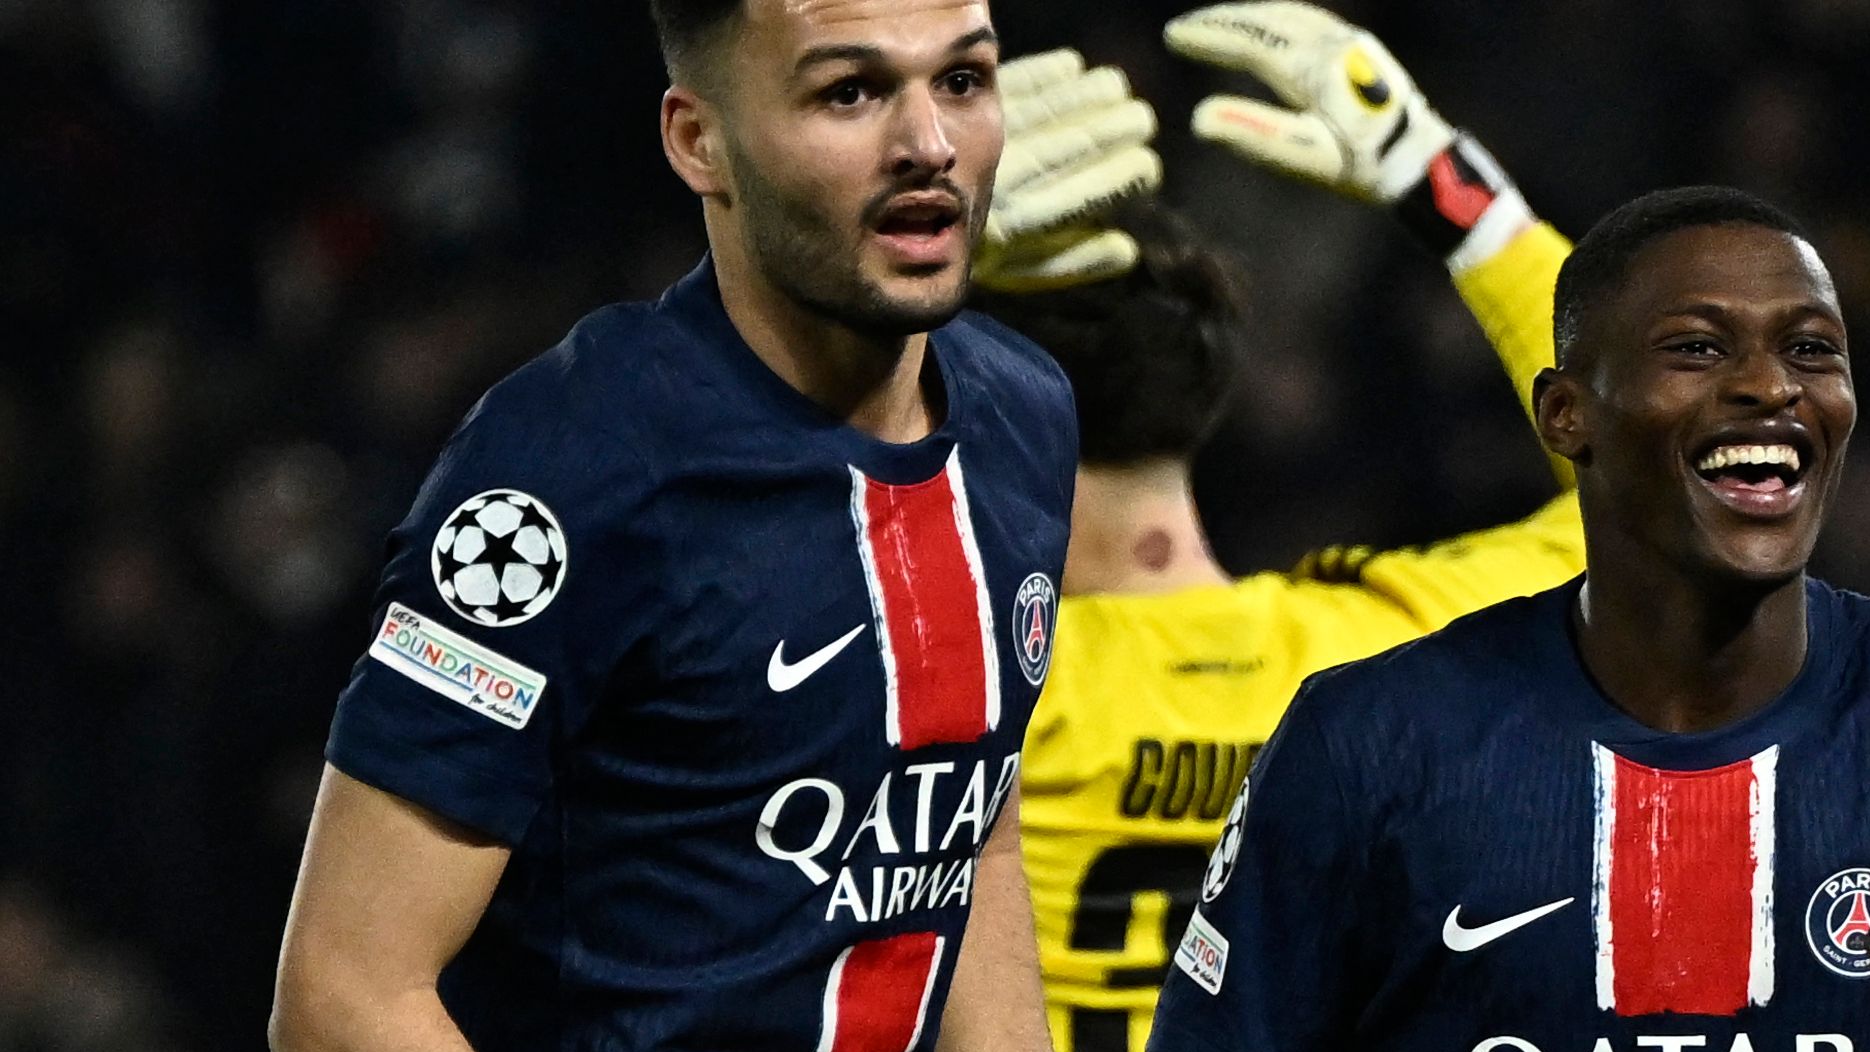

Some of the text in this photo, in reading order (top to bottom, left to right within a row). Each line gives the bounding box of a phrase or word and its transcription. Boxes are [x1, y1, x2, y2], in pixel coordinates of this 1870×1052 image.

[1020, 579, 1051, 607] PARIS
[390, 607, 421, 630] UEFA
[755, 752, 1020, 886] QATAR
